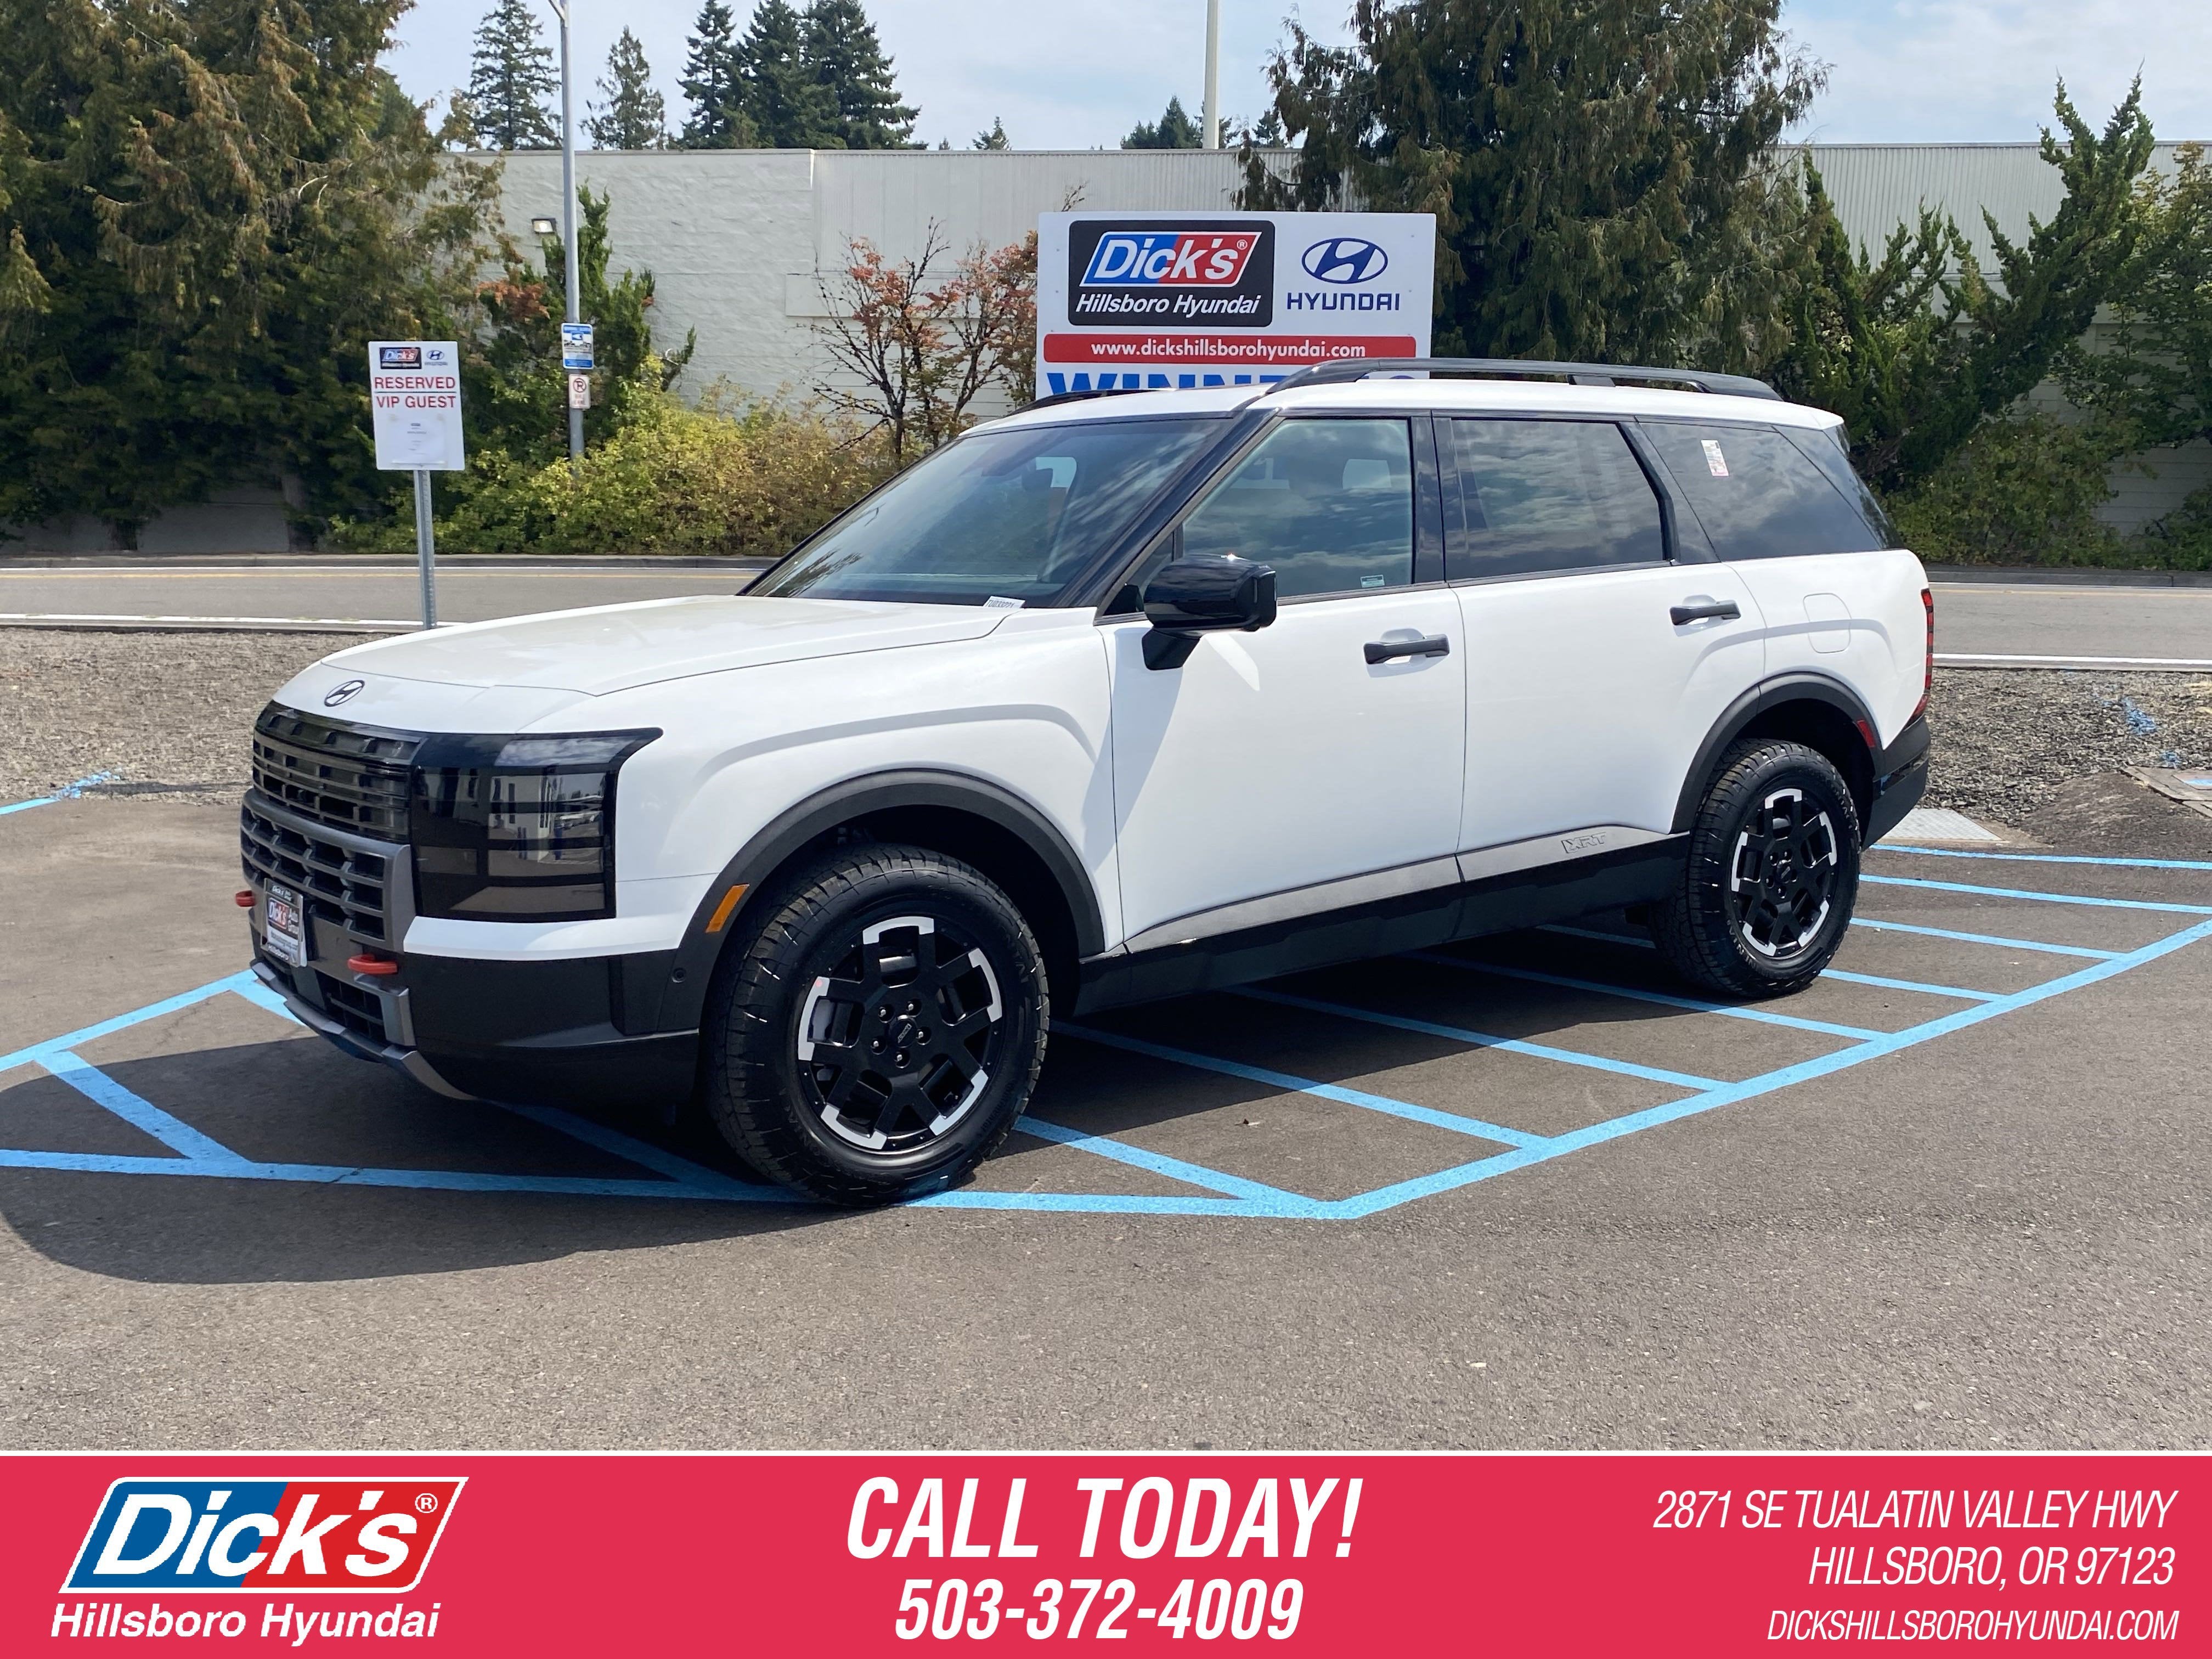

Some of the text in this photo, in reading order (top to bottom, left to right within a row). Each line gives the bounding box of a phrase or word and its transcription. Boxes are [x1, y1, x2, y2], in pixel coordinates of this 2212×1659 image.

[1075, 294, 1261, 318] Hillsboro Hyundai
[1286, 292, 1400, 311] HYUNDAI
[1091, 338, 1366, 361] www.dickshillsborohyundai.com
[375, 376, 455, 389] RESERVED
[376, 396, 456, 408] VIP GUEST
[1561, 832, 1607, 854] XRT
